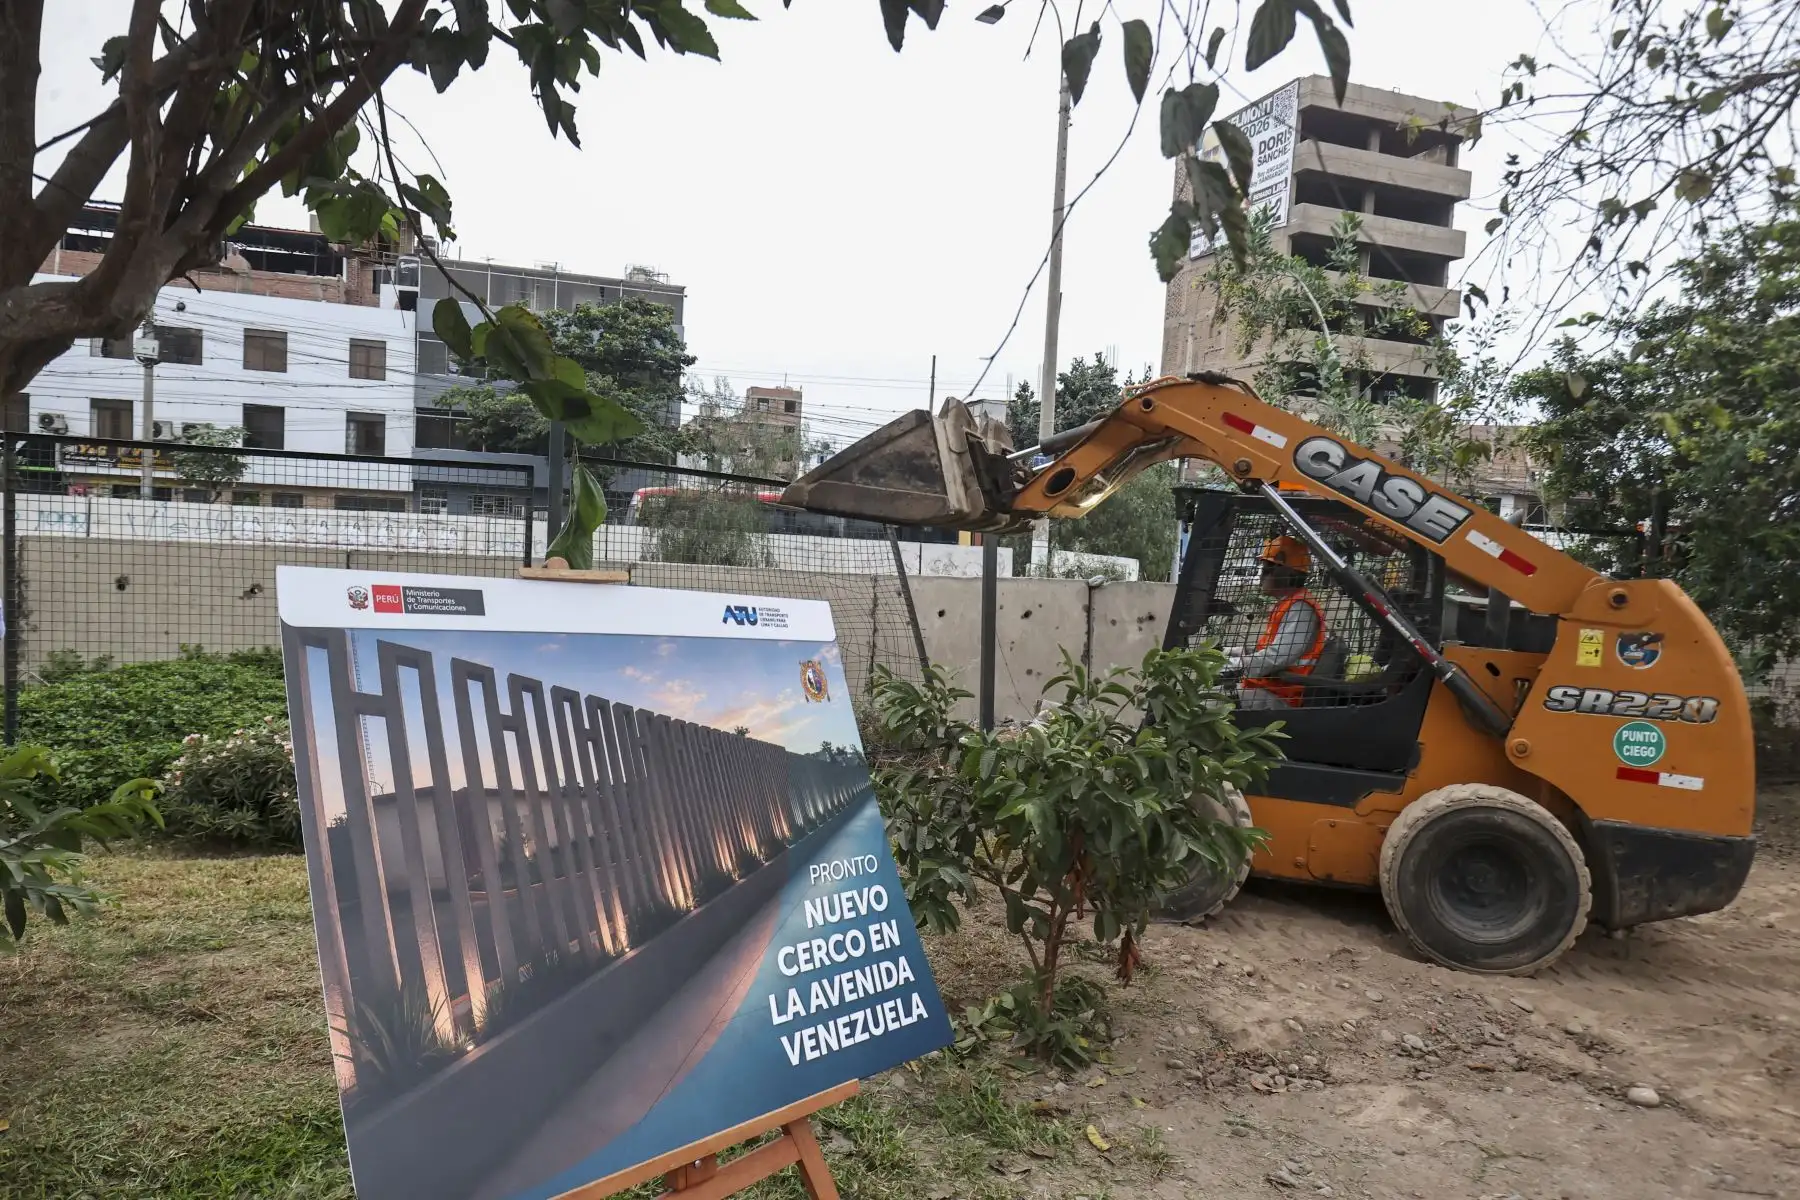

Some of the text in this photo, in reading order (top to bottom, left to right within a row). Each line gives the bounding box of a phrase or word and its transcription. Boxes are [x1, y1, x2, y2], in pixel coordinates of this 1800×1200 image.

[1295, 437, 1472, 542] CASE
[375, 593, 399, 604] PERÚ
[406, 589, 440, 598] Ministerio
[417, 596, 456, 605] Transportes
[413, 603, 467, 612] Comunicaciones
[722, 605, 758, 626] ATU
[1545, 686, 1719, 724] SR220
[1622, 730, 1658, 743] PUNTO
[1623, 745, 1656, 758] CIEGO
[809, 854, 878, 886] PRONTO
[803, 884, 888, 928] NUEVO
[777, 919, 901, 977] CERCO EN
[769, 955, 915, 1026] LA AVENIDA
[780, 992, 929, 1067] VENEZUELA
